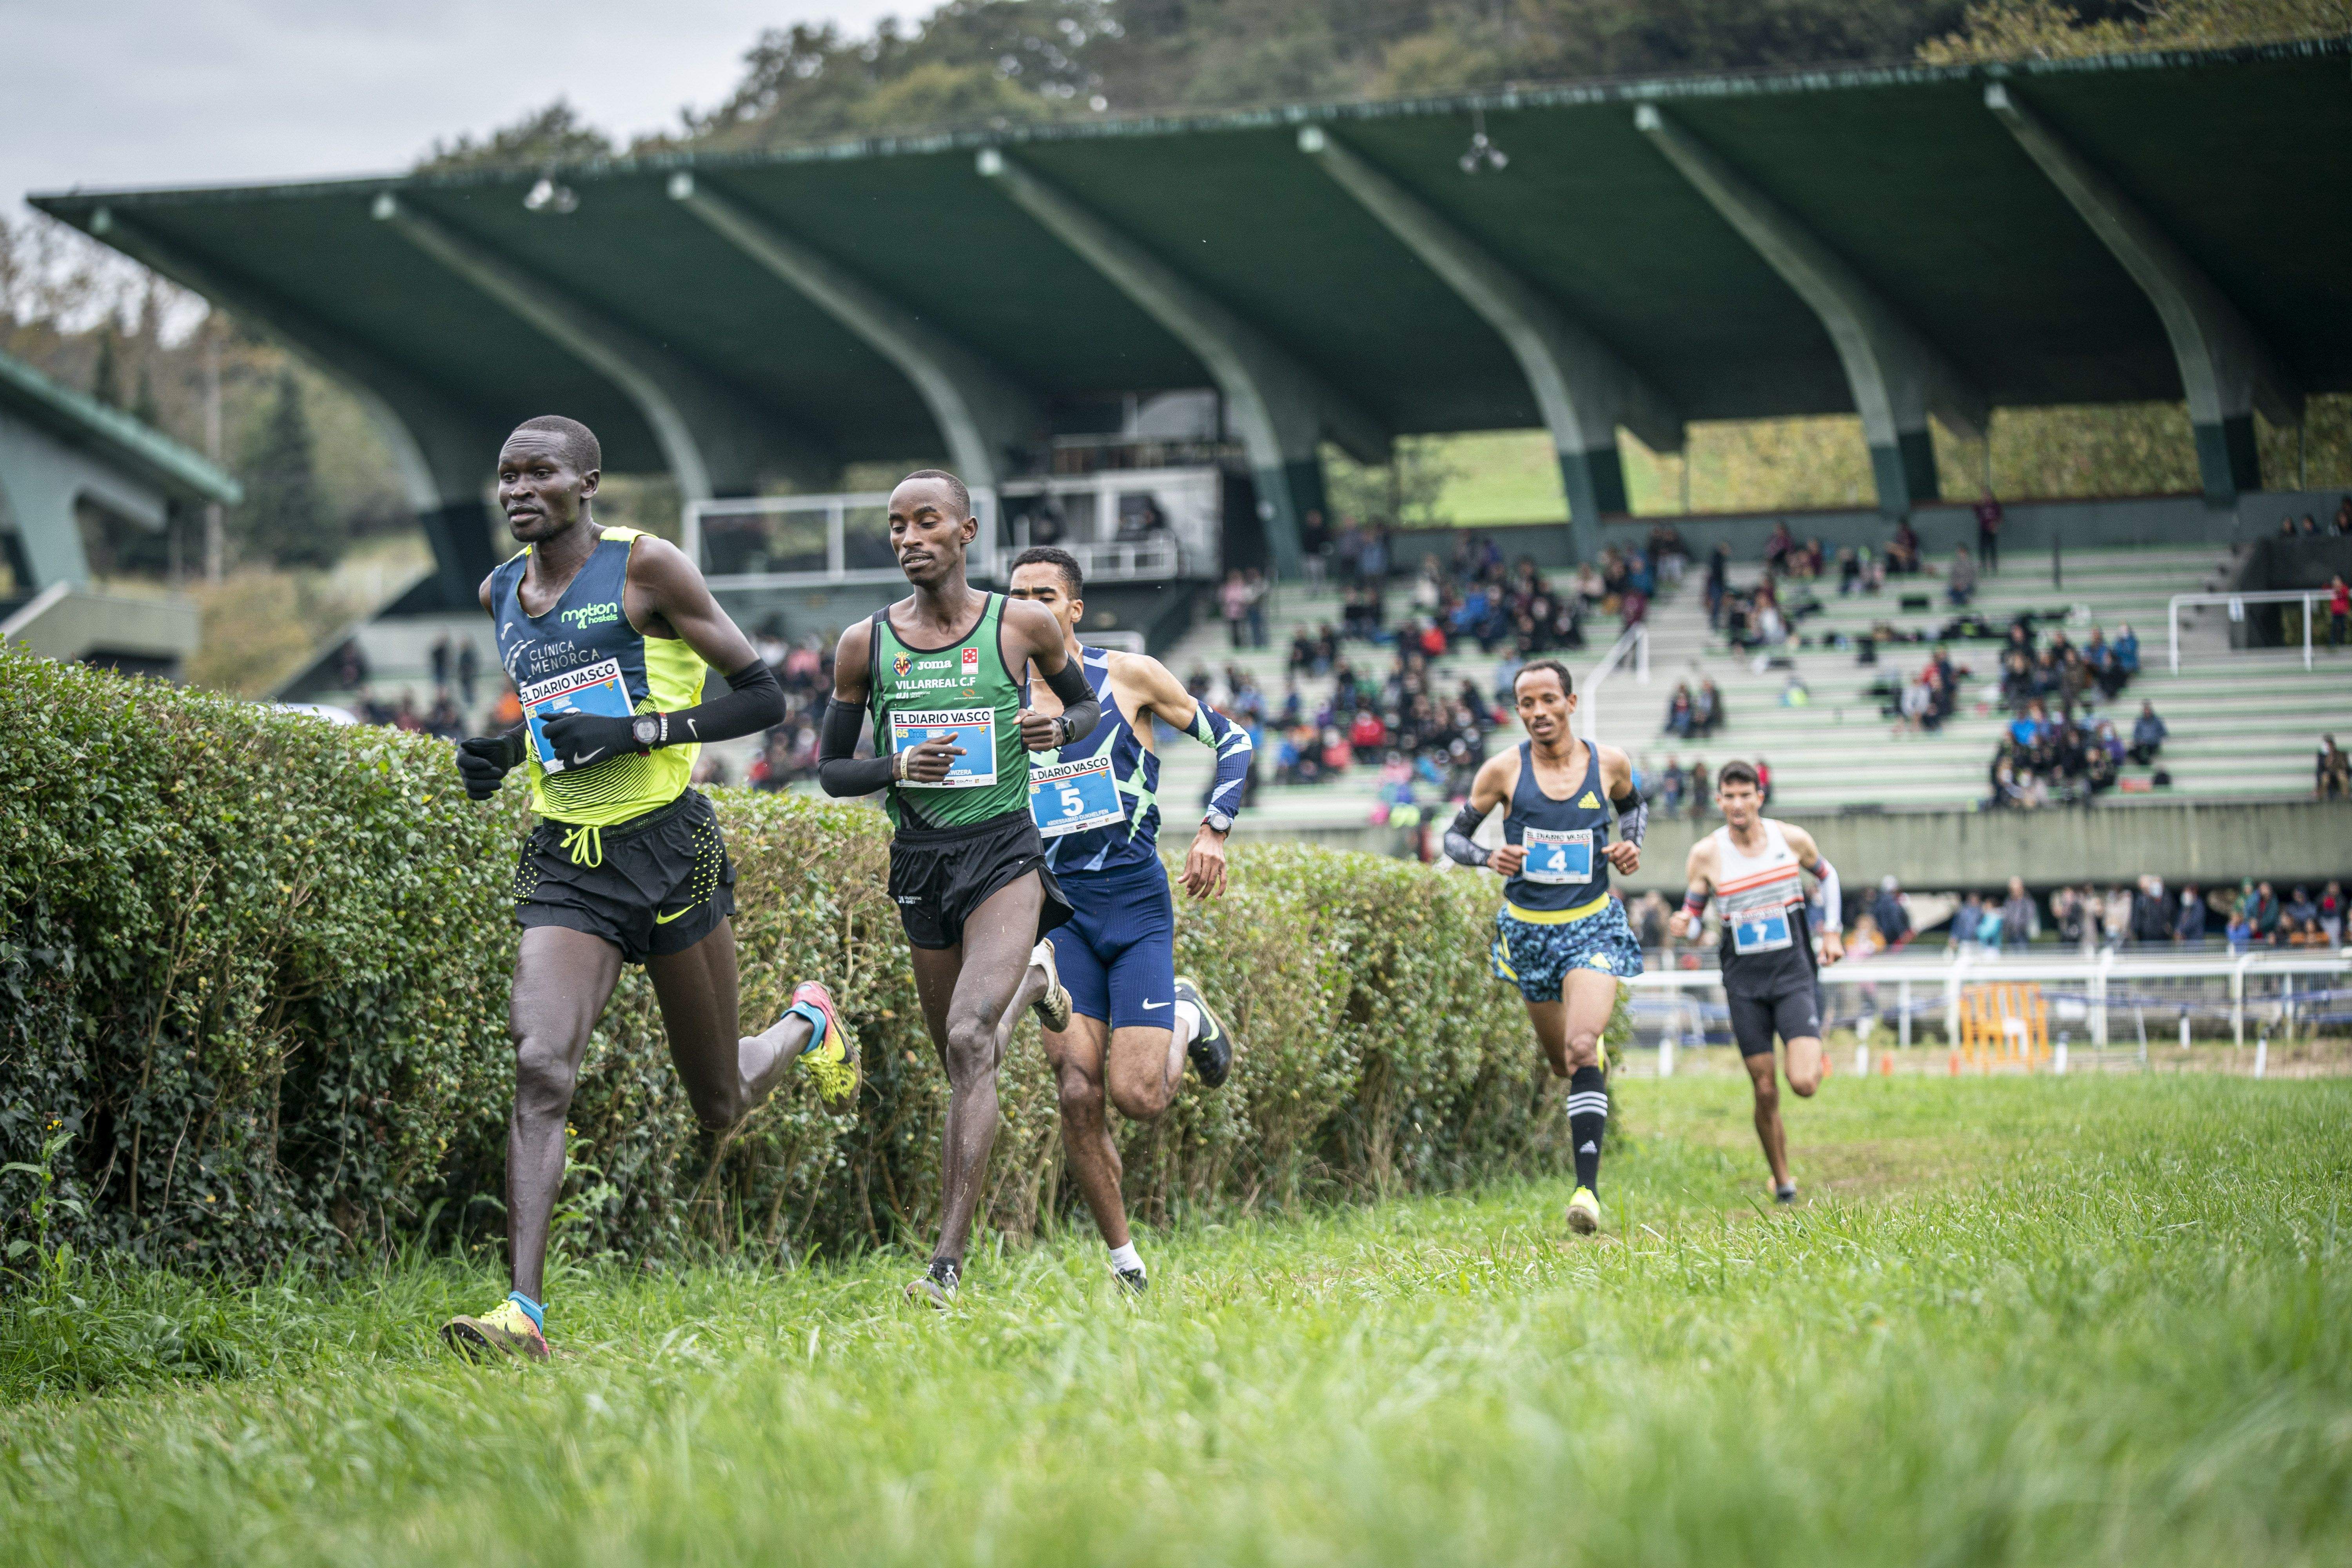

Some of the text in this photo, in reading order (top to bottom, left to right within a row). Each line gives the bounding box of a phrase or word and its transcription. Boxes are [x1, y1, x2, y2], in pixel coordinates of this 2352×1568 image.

[561, 602, 617, 629] motion
[588, 613, 618, 624] hostels
[530, 640, 575, 661] CLÍNICA
[531, 649, 601, 675] MENORCA
[532, 677, 570, 699] DIARIO
[571, 663, 615, 685] VASCO
[895, 677, 976, 690] VILLARREAL C.F
[894, 711, 990, 724] EL DIARIO VASCO
[896, 729, 909, 738] 65
[909, 729, 926, 738] Cross
[1038, 766, 1071, 779] DIARIO
[1073, 758, 1108, 772] VASCO
[1061, 788, 1084, 817] 5
[1047, 816, 1078, 826] ABDESSAMAD
[1080, 809, 1109, 820] OUKHELFEN
[1548, 850, 1567, 871] 4
[1752, 923, 1768, 942] 7
